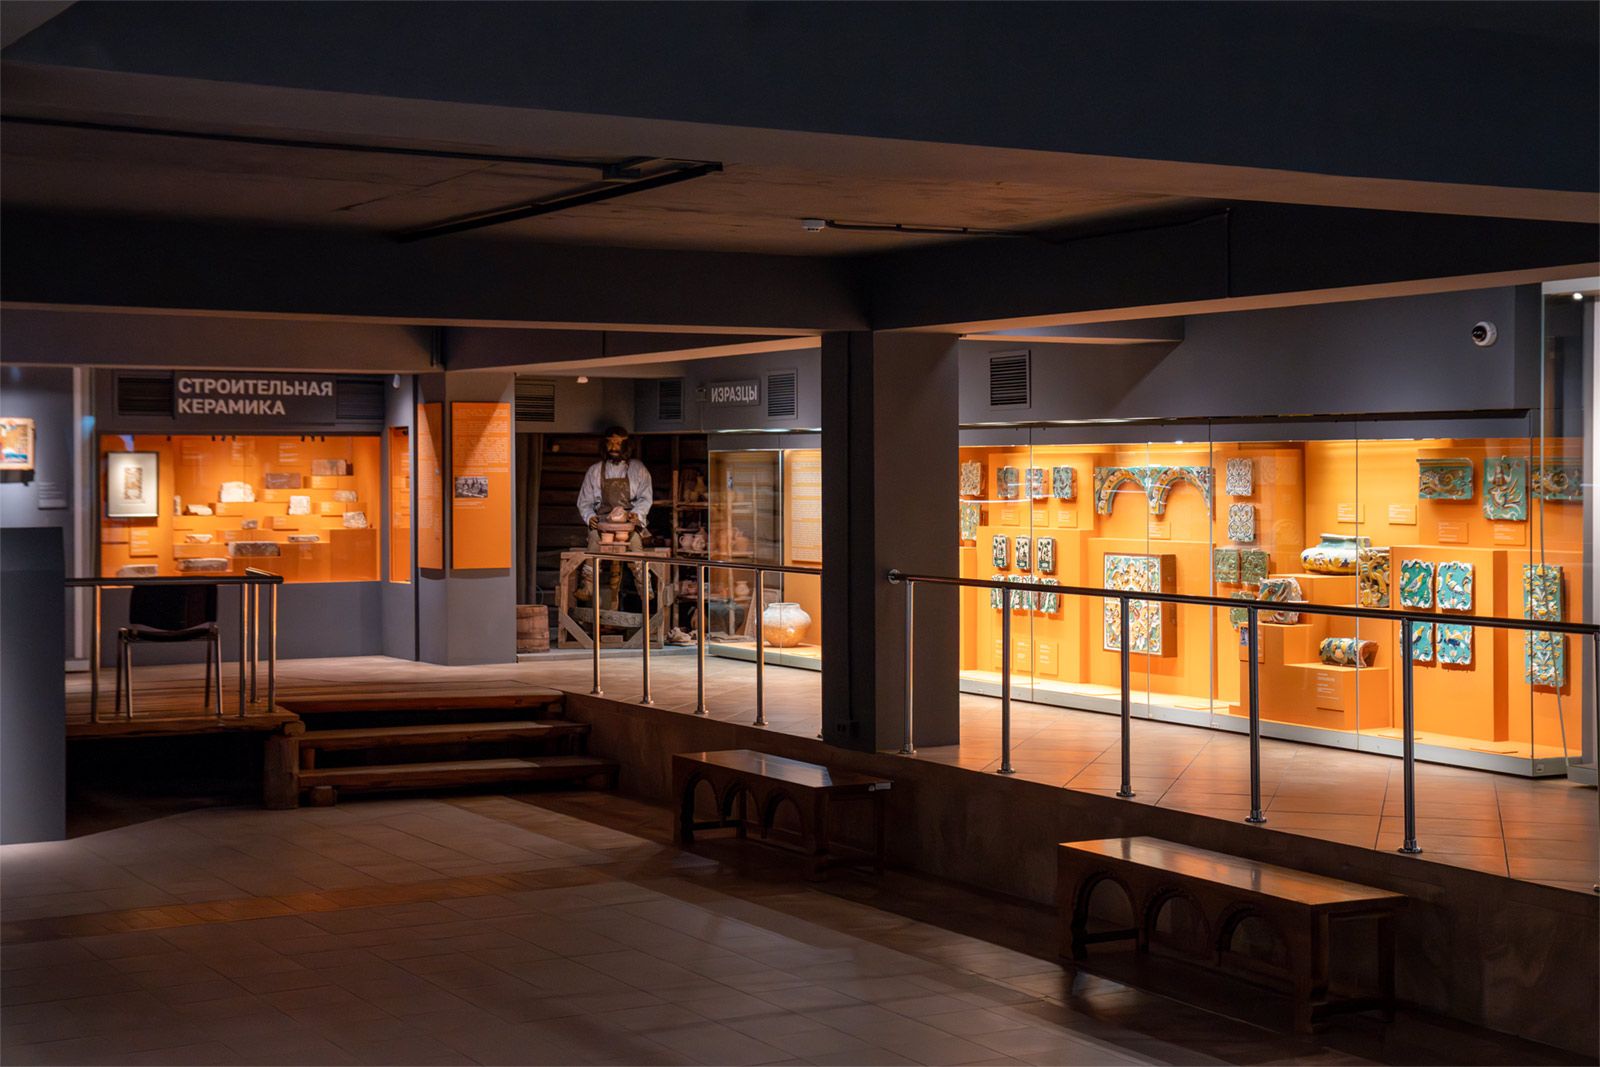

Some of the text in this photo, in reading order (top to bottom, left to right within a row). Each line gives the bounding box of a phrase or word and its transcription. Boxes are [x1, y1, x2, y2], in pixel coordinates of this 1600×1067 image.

[178, 378, 333, 396] СТРОИТЕЛЬНАЯ
[711, 385, 758, 404] ИЗРАЗЦЫ
[178, 398, 286, 415] КЕРАМИКА
